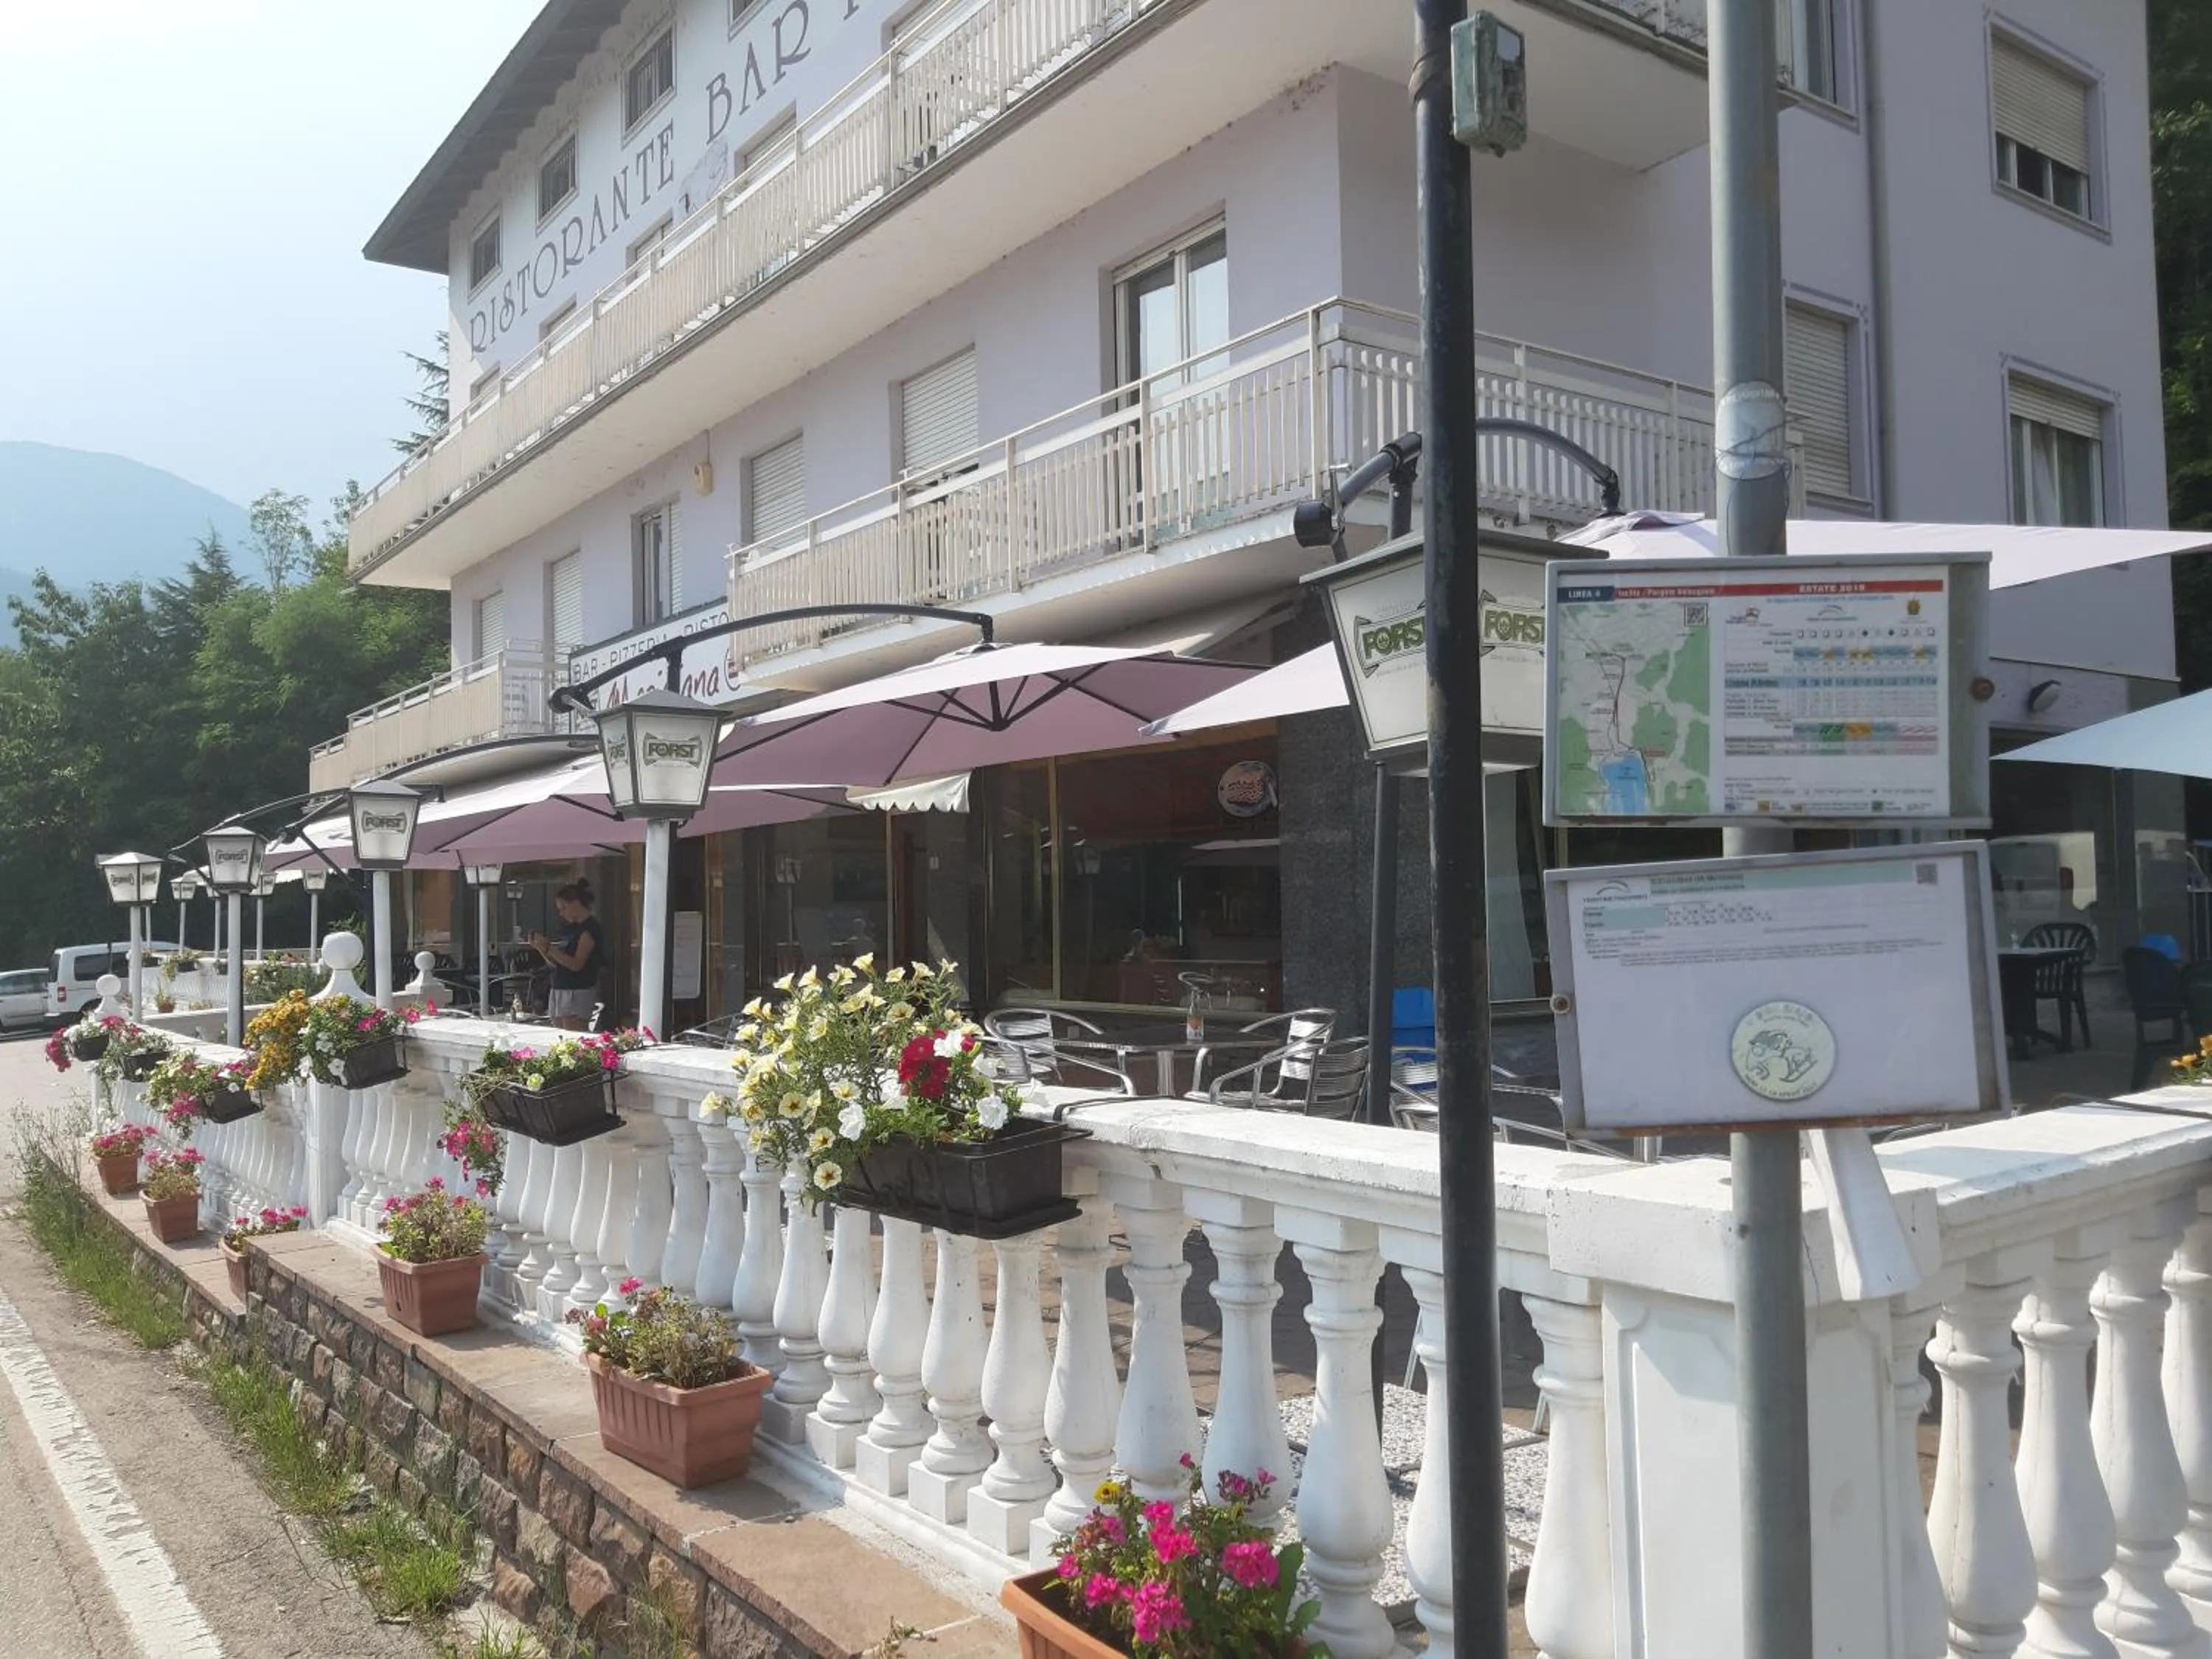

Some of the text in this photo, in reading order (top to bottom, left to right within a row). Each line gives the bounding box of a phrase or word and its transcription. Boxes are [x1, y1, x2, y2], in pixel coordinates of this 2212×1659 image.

[470, 0, 812, 362] RISTORANTE BAR
[572, 658, 598, 684] BAR
[648, 742, 696, 758] FORST
[365, 816, 403, 828] FORST
